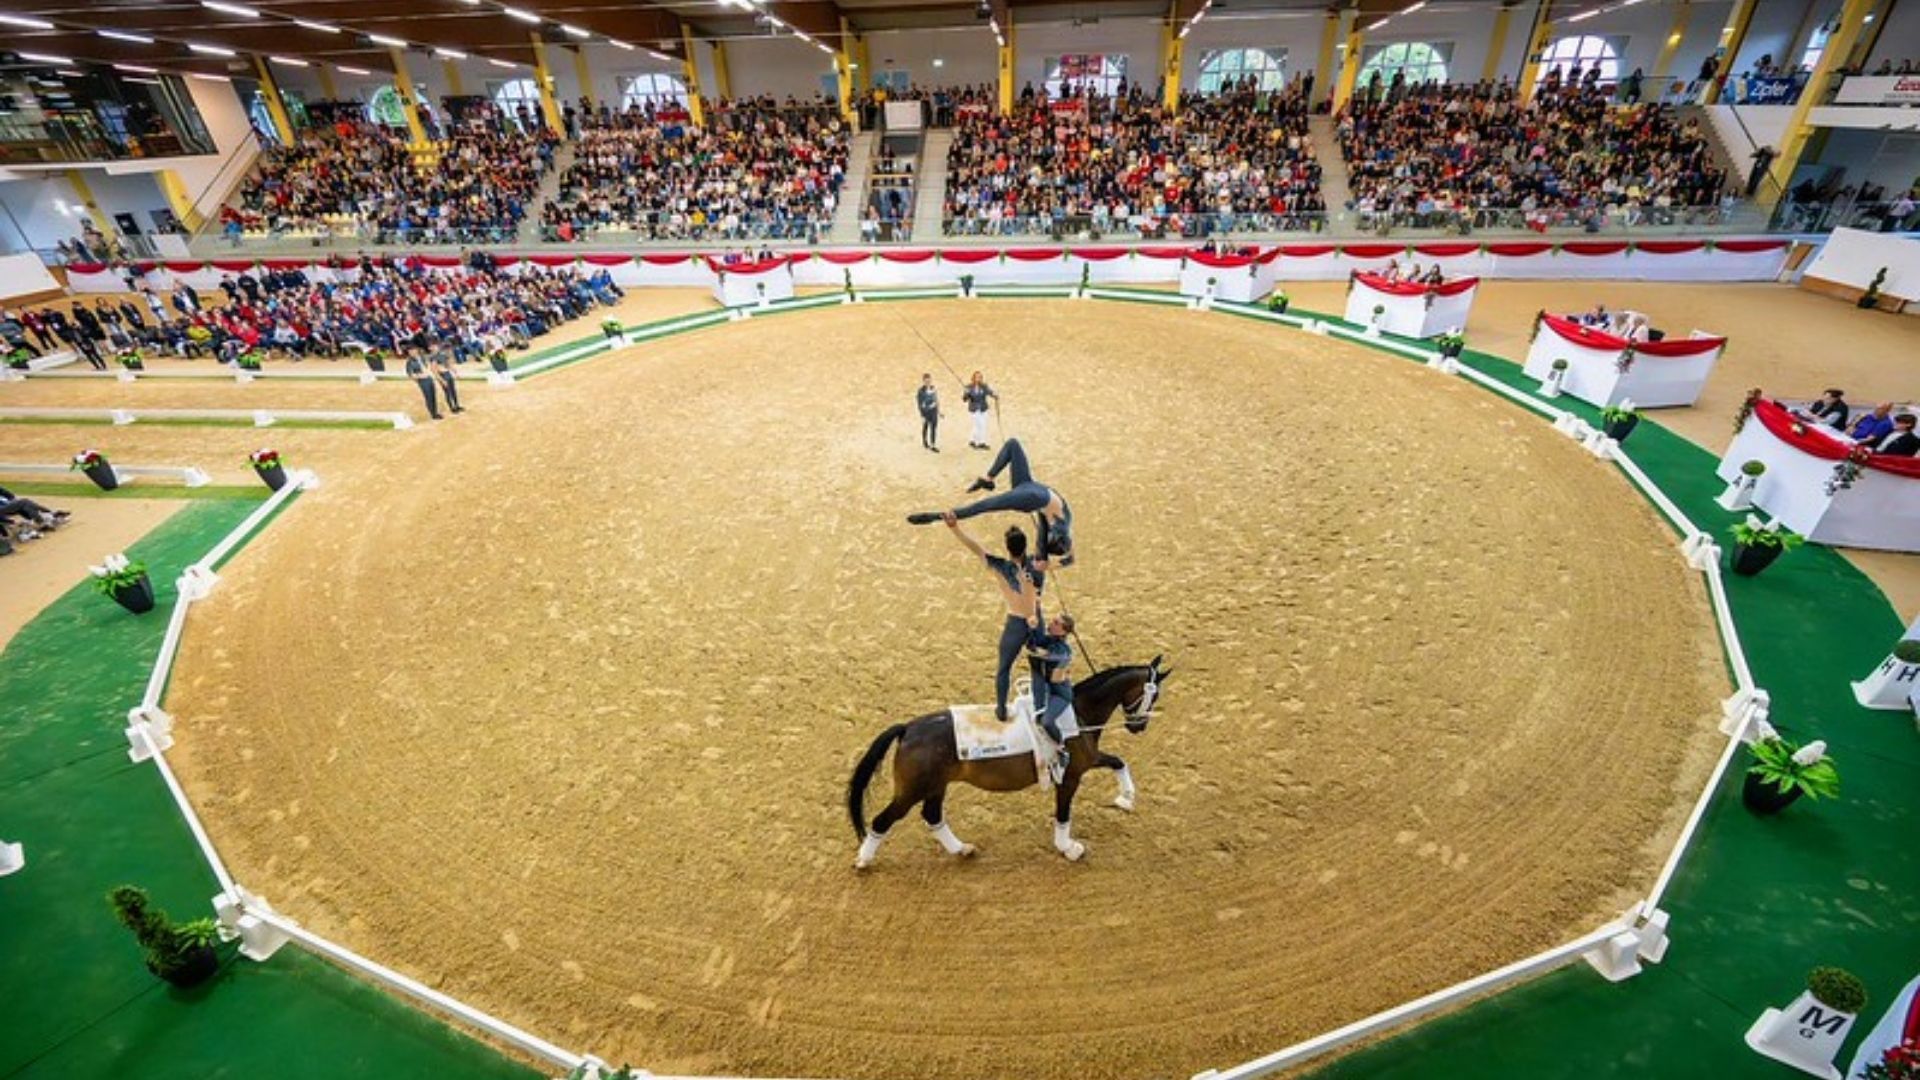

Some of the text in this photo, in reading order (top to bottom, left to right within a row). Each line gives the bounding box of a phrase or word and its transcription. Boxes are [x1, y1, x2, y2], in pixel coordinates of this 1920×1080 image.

[1744, 478, 1757, 490] A
[1896, 666, 1920, 682] H
[1799, 1006, 1847, 1035] M
[1799, 1028, 1815, 1038] G
